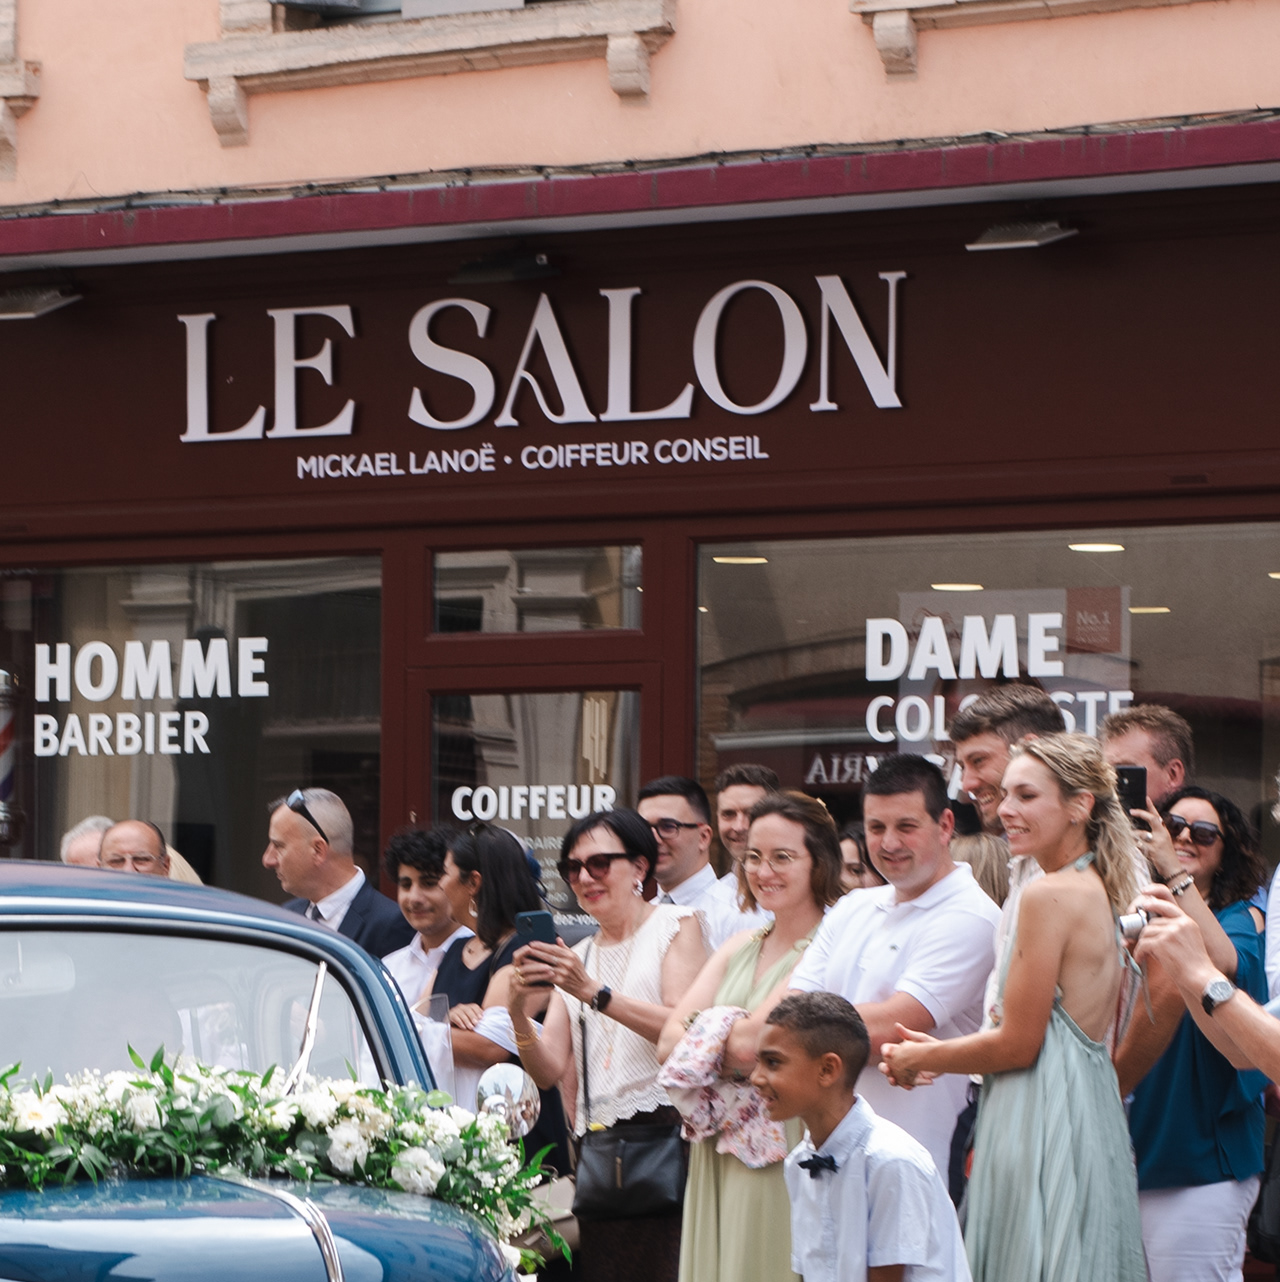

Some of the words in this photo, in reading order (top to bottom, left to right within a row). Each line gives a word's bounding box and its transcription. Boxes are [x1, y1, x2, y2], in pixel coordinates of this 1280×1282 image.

[177, 303, 356, 443] LE
[408, 270, 906, 431] SALON
[296, 449, 405, 480] MICKAEL
[410, 442, 497, 475] LANOË
[519, 439, 649, 471] COIFFEUR
[653, 434, 769, 467] CONSEIL
[35, 636, 269, 702] HOMME
[866, 612, 1065, 681] DAME
[35, 710, 211, 757] BARBIER
[451, 784, 616, 821] COIFFEUR
